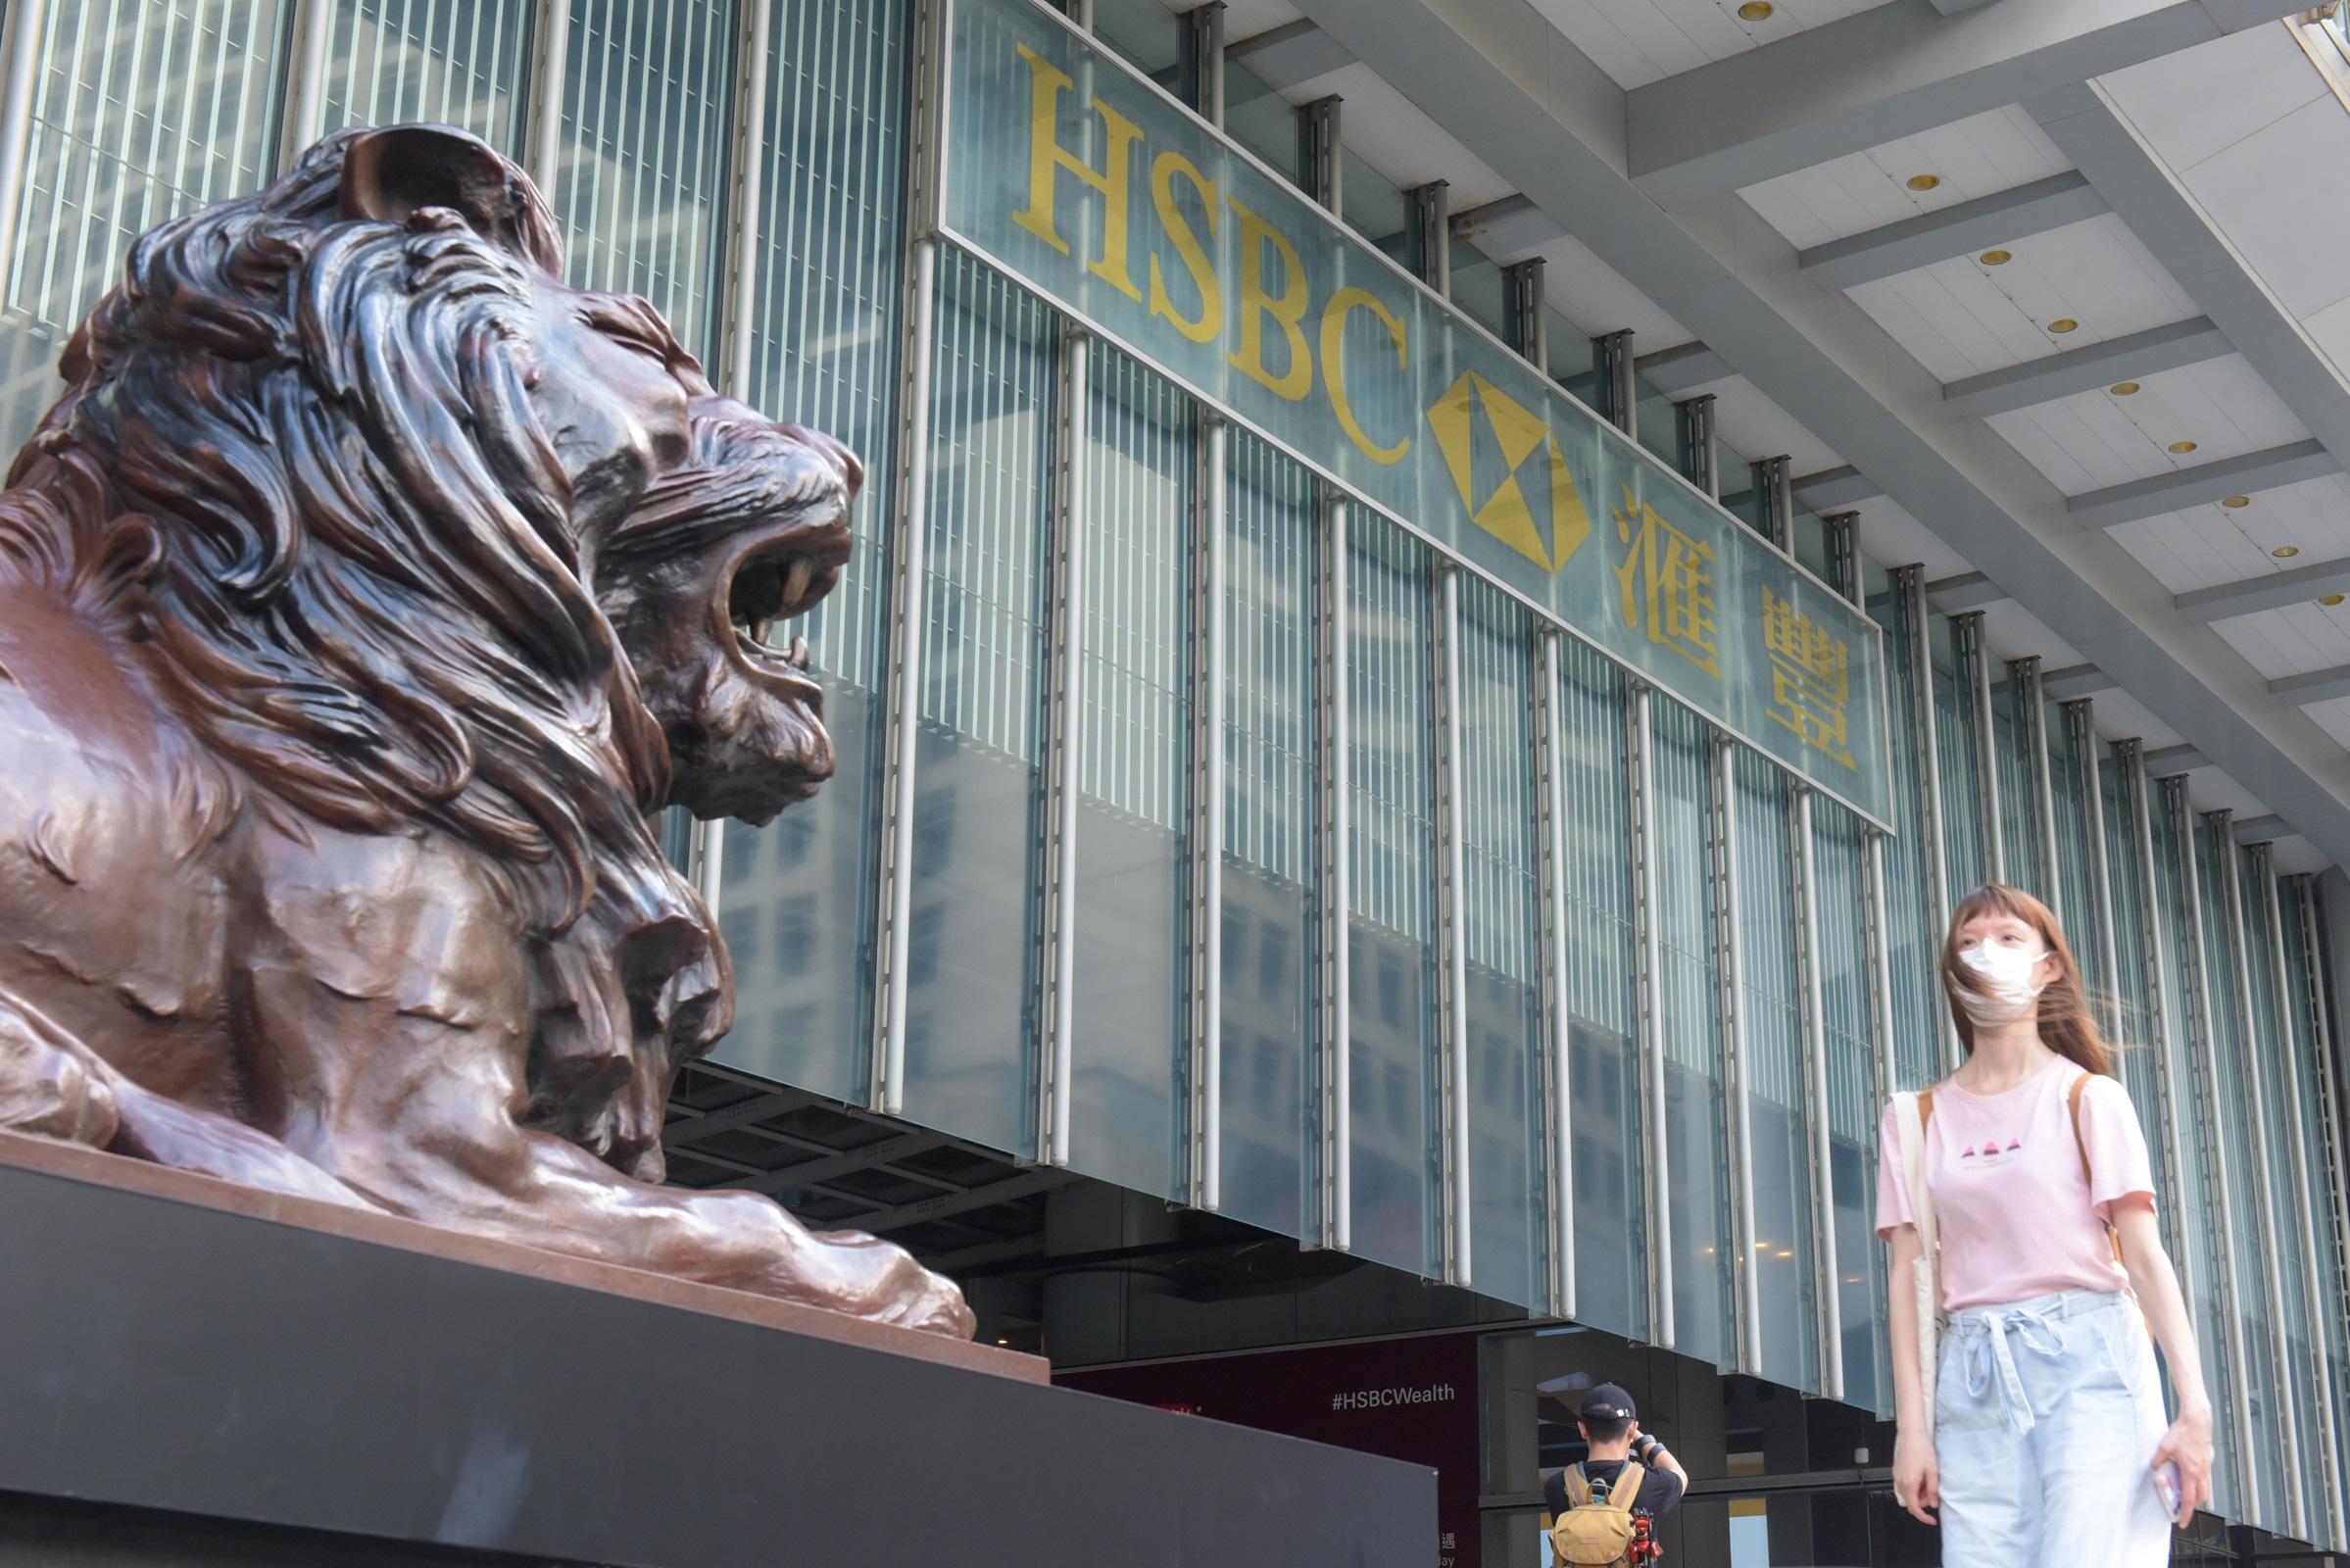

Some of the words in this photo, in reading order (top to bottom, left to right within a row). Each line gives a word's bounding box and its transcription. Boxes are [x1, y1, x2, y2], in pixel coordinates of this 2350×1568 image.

[1011, 42, 1410, 466] HSBC
[1332, 1382, 1455, 1411] #HSBCWealth
[1438, 1533, 1456, 1550] 遇
